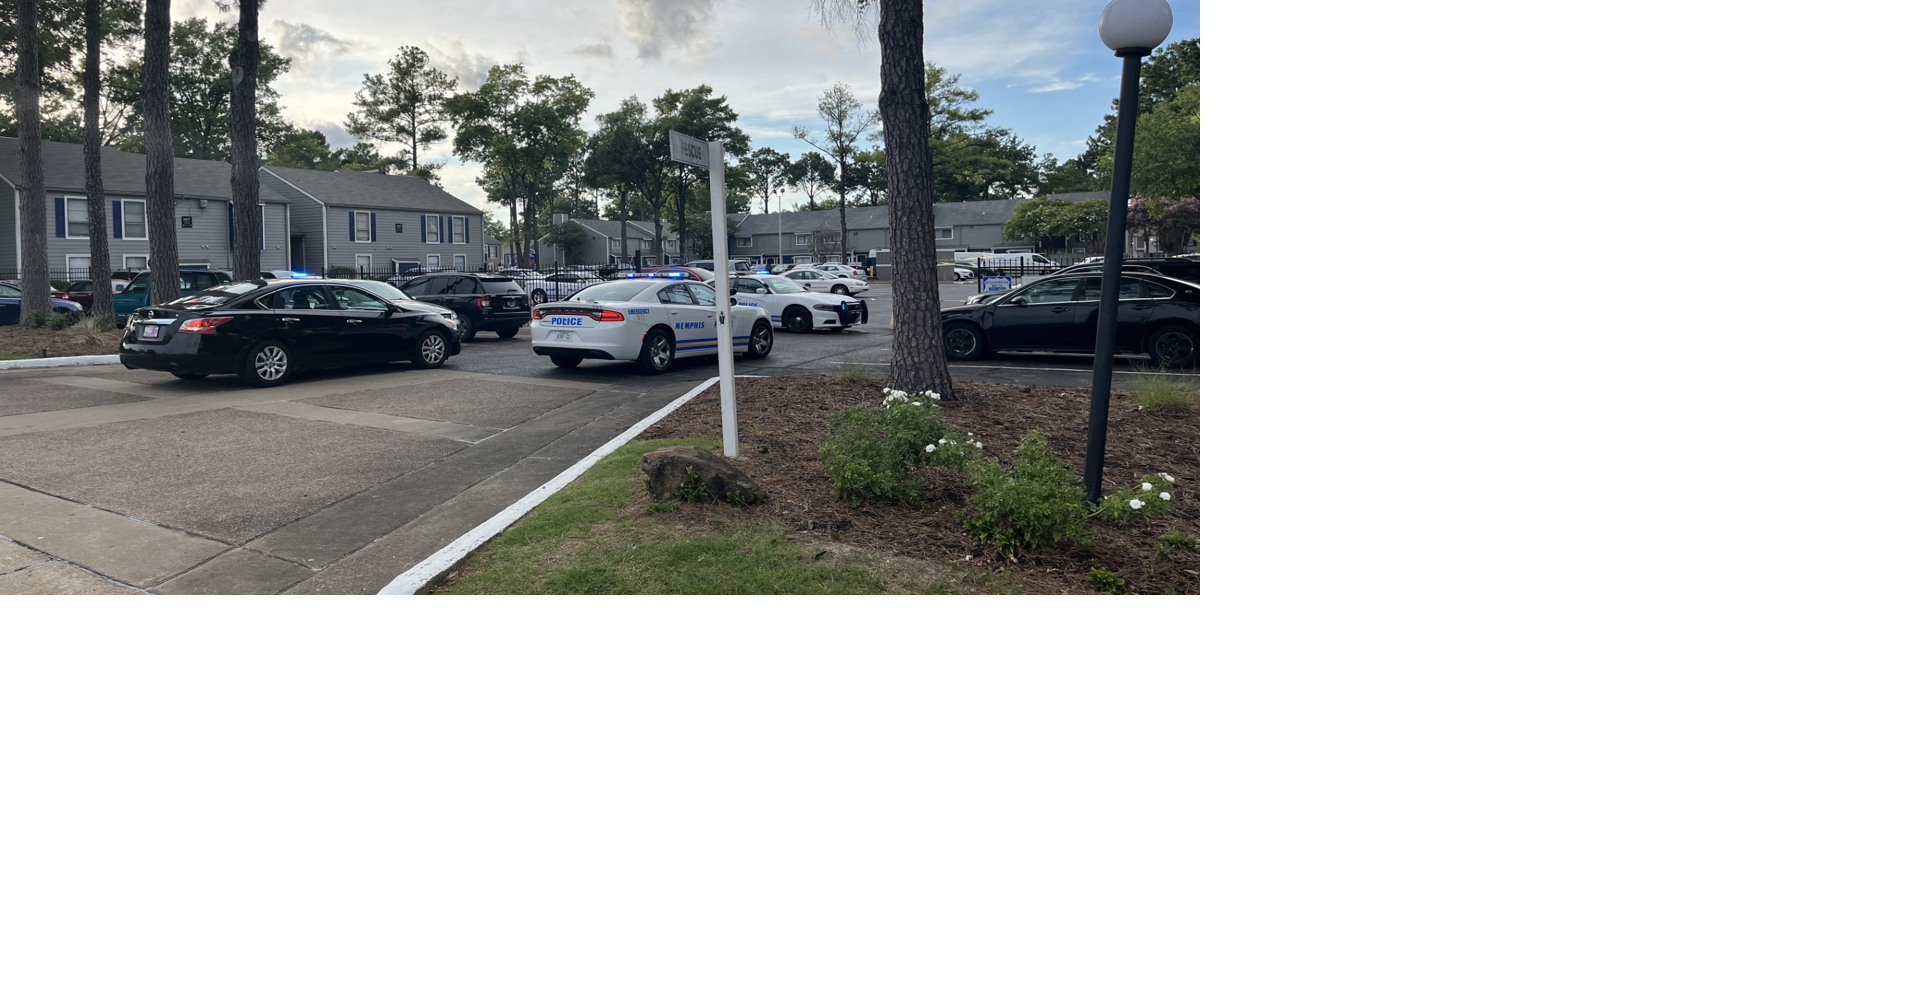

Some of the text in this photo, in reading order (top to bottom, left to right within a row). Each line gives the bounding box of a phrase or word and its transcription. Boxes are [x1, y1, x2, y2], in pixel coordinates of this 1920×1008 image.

[681, 141, 702, 160] FESCUE
[551, 317, 583, 326] POLICE
[675, 321, 705, 330] MEMPHIS
